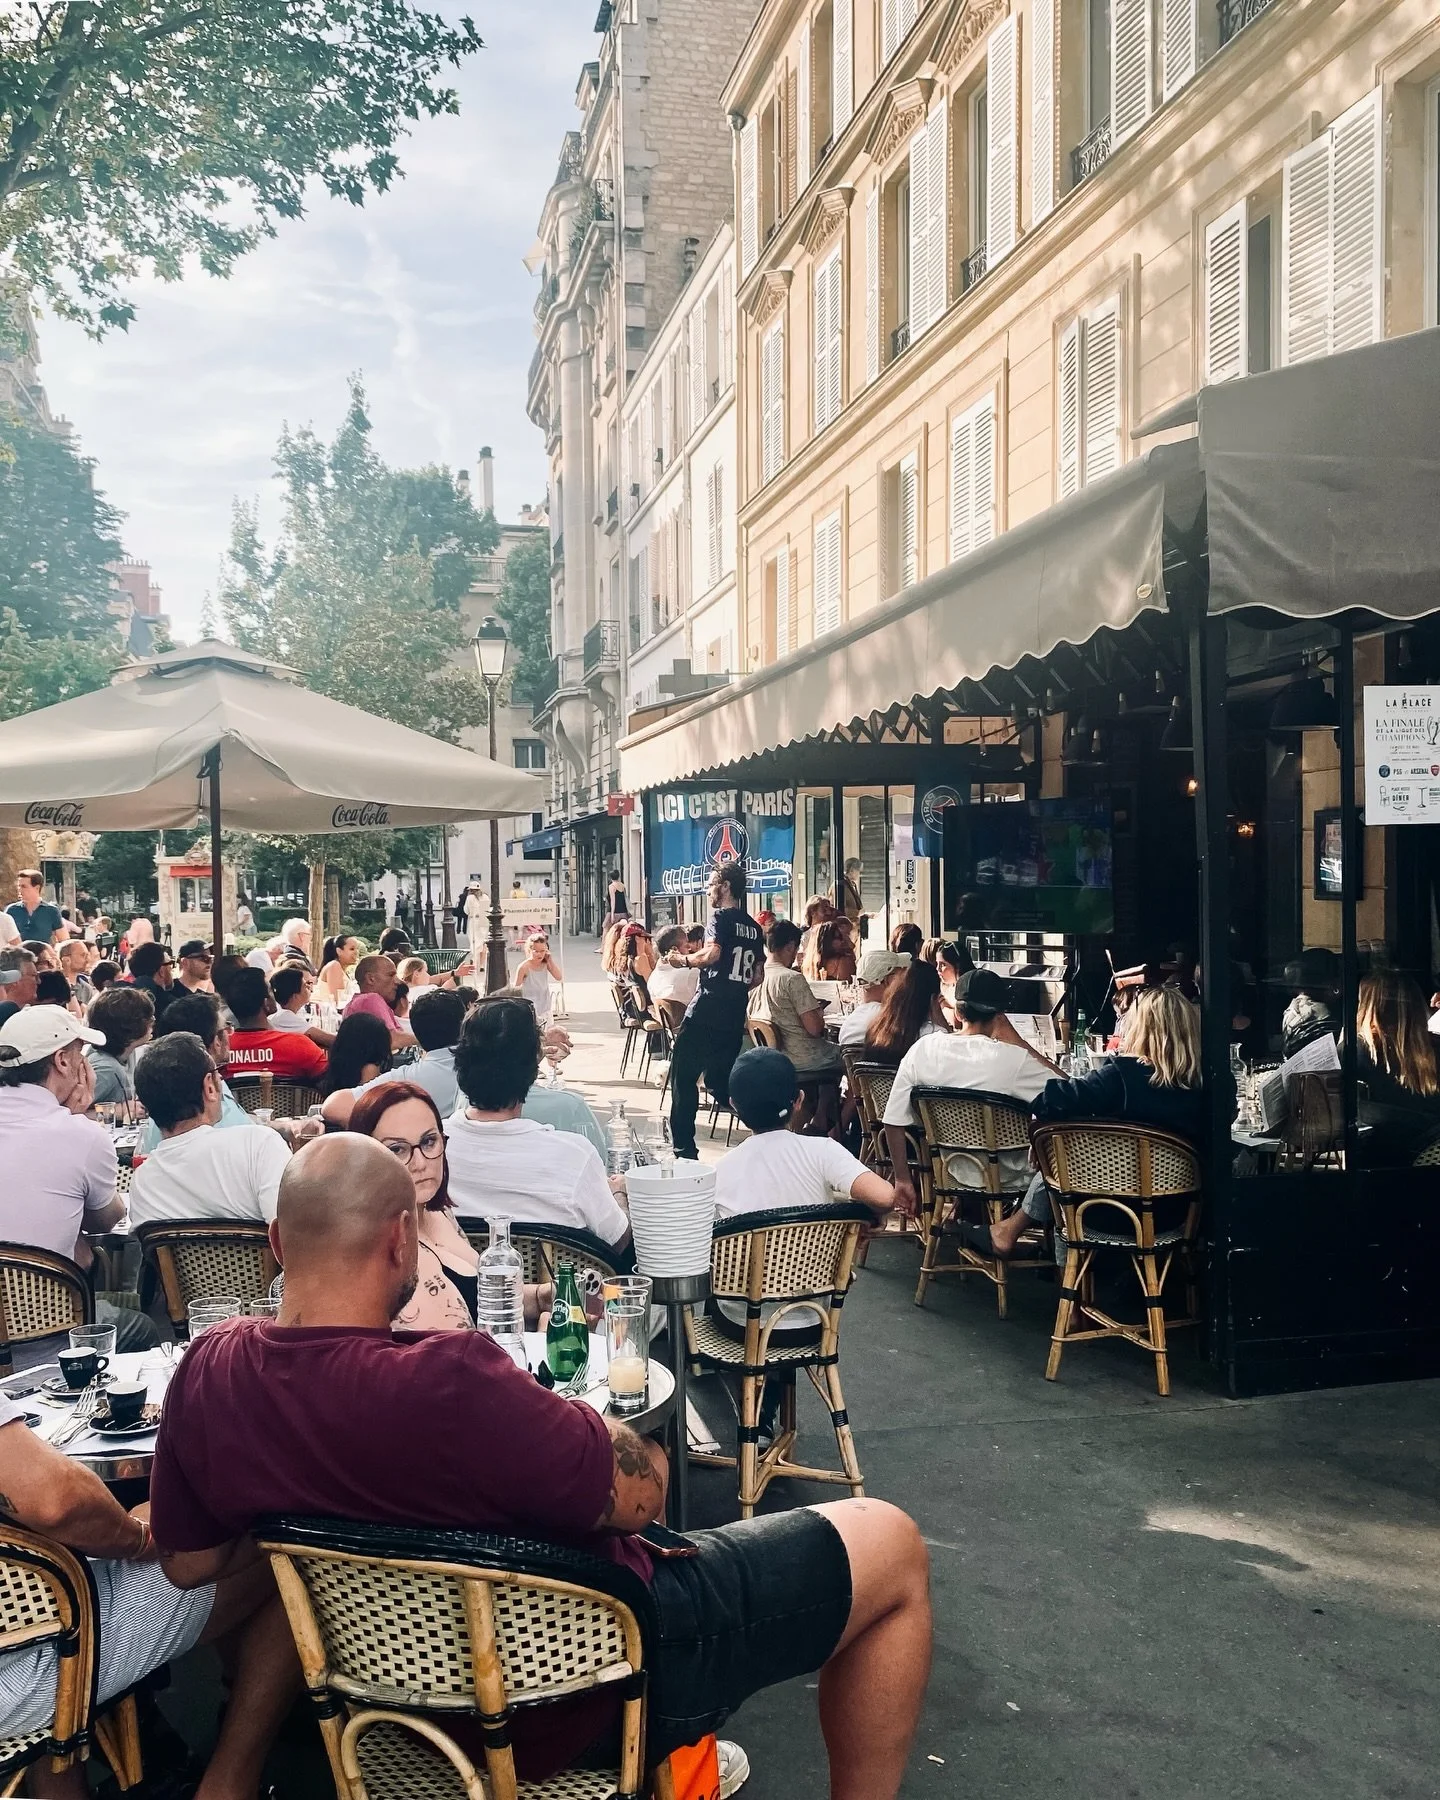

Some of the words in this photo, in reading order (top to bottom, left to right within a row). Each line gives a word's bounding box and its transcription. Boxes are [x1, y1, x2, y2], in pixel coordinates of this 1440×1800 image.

[1386, 699, 1397, 707] LA
[1402, 698, 1432, 707] PLACE
[1376, 718, 1388, 727] LA
[1392, 718, 1425, 727] FINALE
[1375, 734, 1426, 742] CHAMPIONS
[656, 794, 685, 822] ICI
[688, 789, 738, 819] C'EST
[741, 788, 794, 816] PARIS
[728, 946, 755, 984] 18
[229, 1047, 273, 1064] ONALDO
